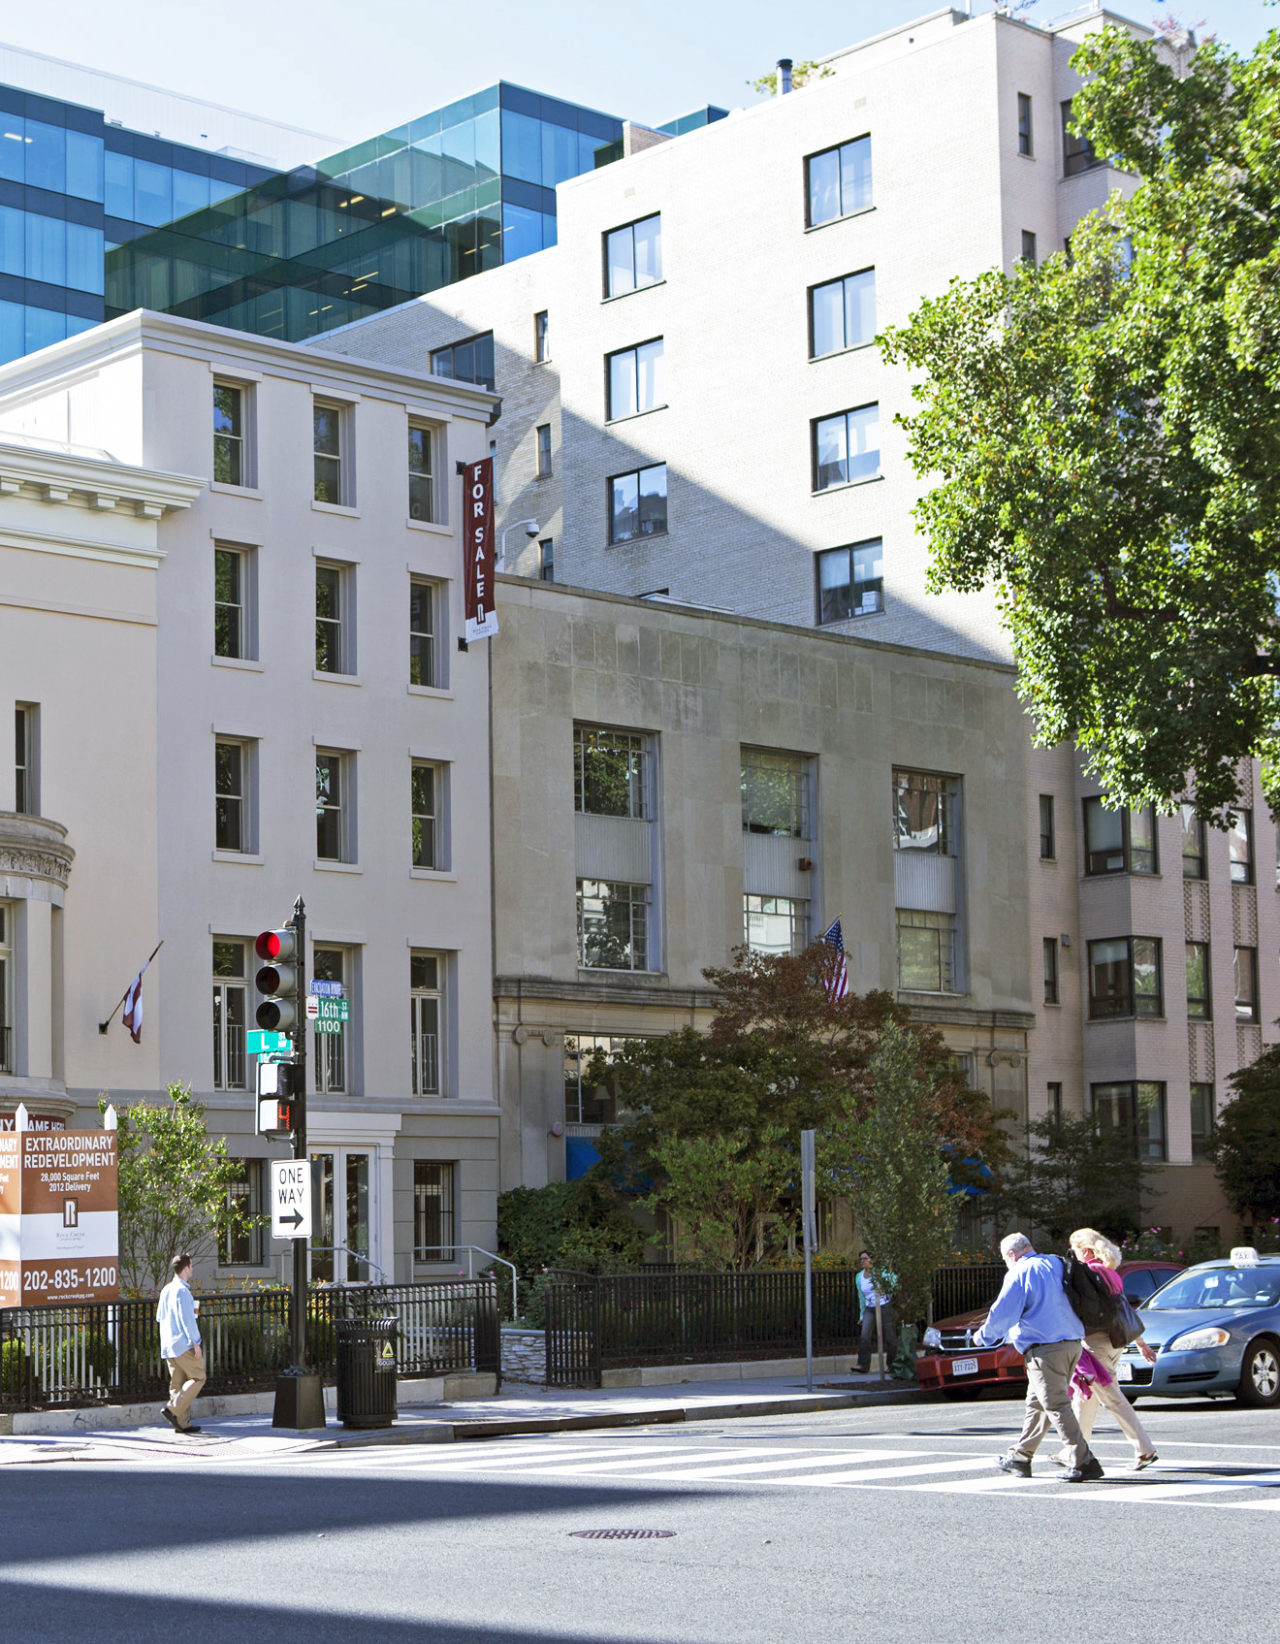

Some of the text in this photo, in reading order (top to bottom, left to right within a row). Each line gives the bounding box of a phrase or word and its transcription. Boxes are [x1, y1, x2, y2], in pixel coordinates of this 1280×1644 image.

[472, 464, 485, 598] FOR SALE
[320, 1001, 339, 1018] 16th
[341, 1002, 348, 1010] ST
[317, 1021, 340, 1032] 1100
[261, 1033, 270, 1049] L
[28, 1119, 50, 1132] AME
[25, 1135, 114, 1152] EXTRAORDINARY
[24, 1152, 115, 1168] REDEVELOPMENT
[40, 1171, 100, 1183] 28,000 Square Feet
[279, 1168, 303, 1184] ONE
[49, 1182, 91, 1192] 2012 Delivery
[278, 1188, 304, 1204] WAY
[24, 1267, 116, 1290] 202-835-1200
